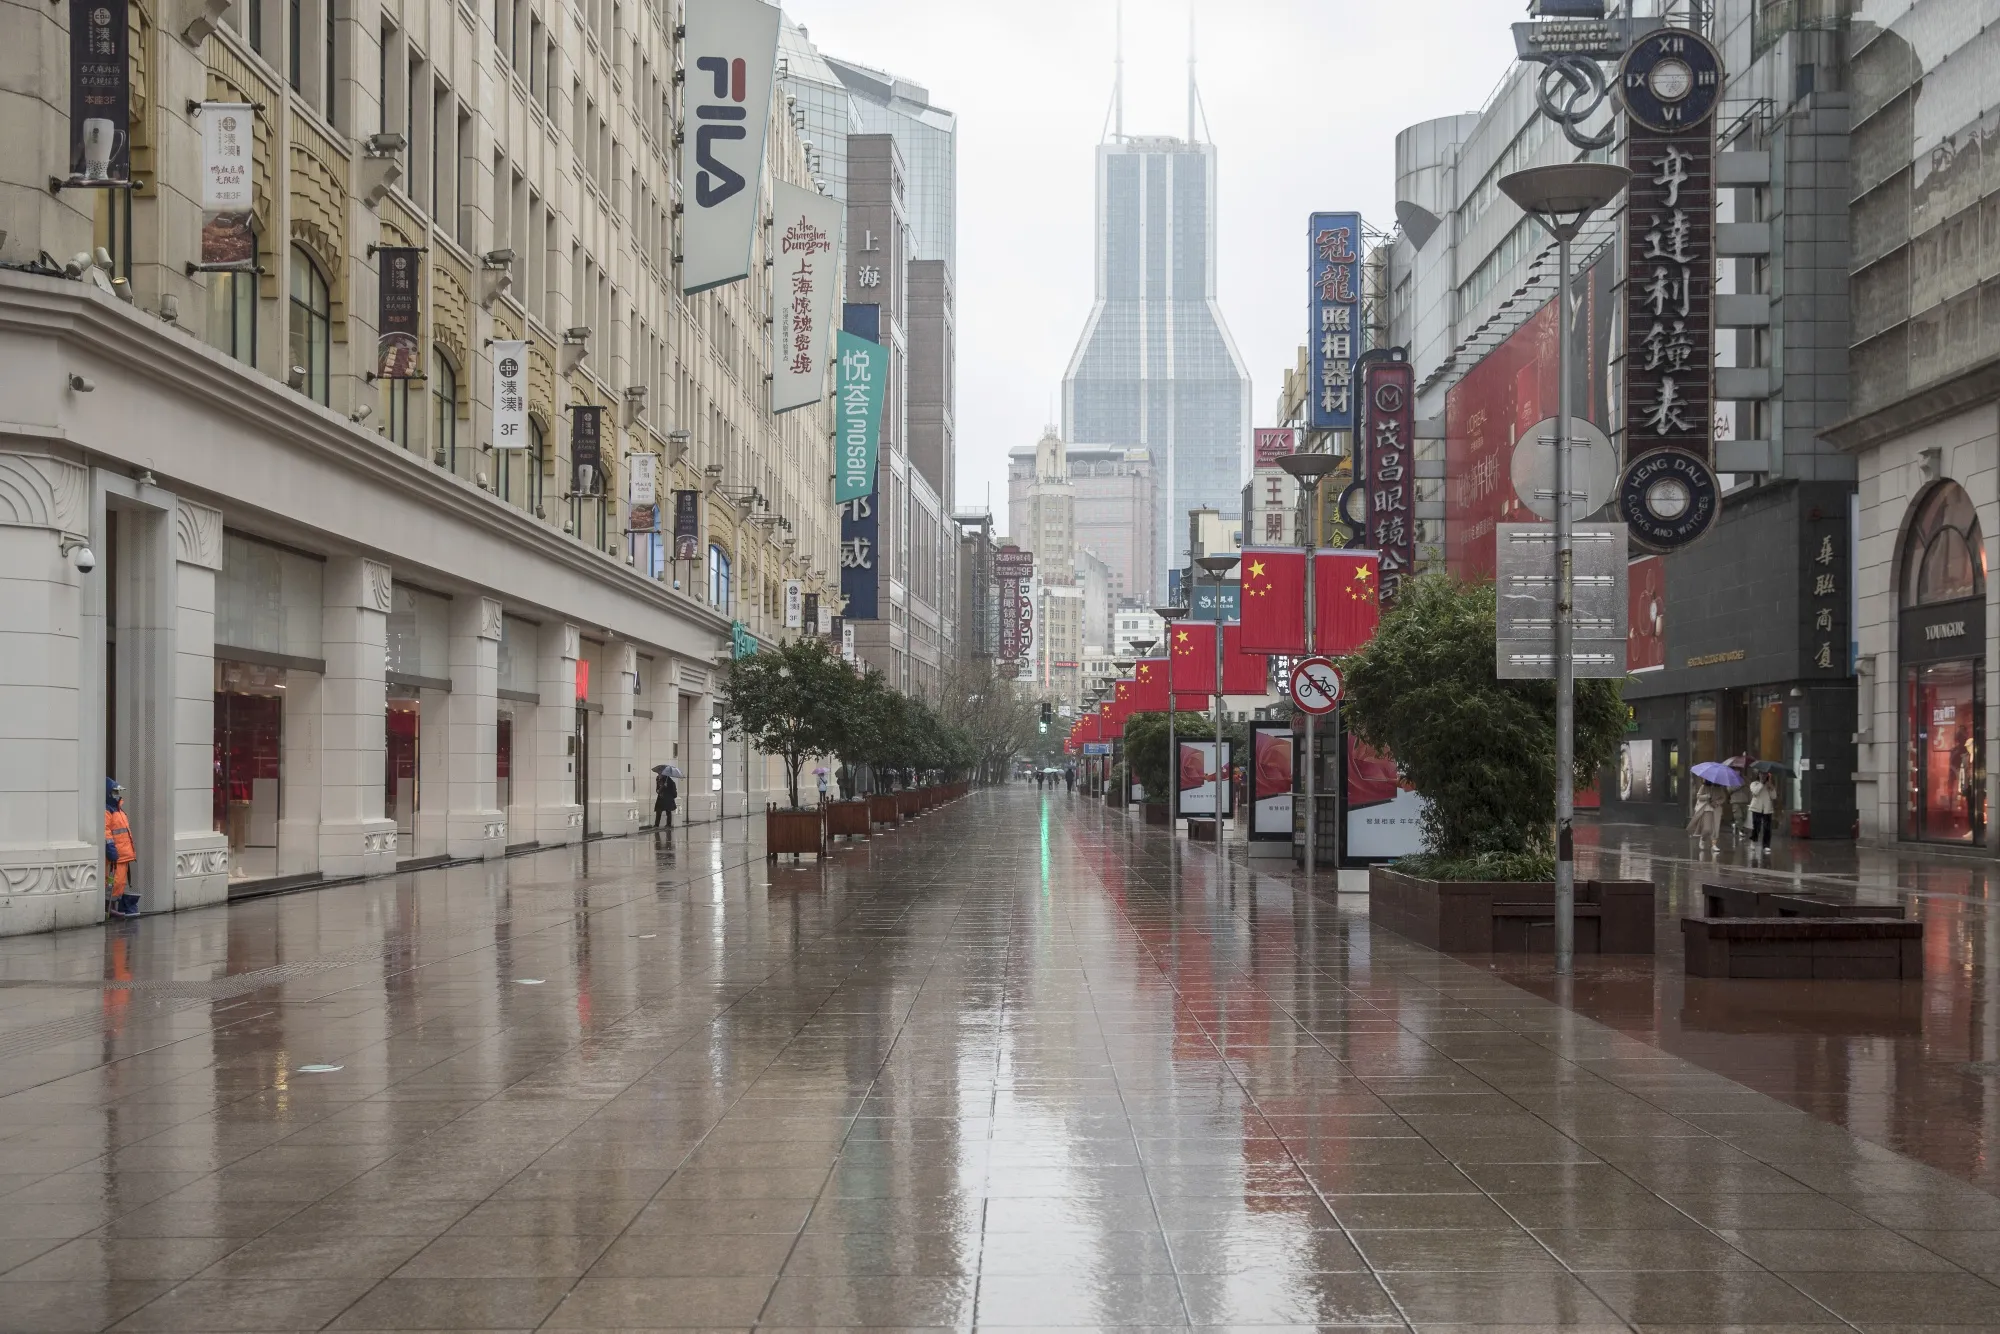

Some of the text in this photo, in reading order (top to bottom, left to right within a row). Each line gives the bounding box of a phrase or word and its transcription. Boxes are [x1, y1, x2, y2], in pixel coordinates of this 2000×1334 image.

[1659, 37, 1684, 53] XII
[1627, 73, 1646, 87] IX
[1698, 71, 1715, 86] III
[1662, 107, 1682, 121] VI
[696, 56, 747, 209] FILA
[797, 215, 814, 232] the
[858, 229, 881, 287] 上海
[842, 349, 871, 415] 悦荟
[500, 423, 519, 436] 3F
[1259, 433, 1289, 447] WK
[1630, 458, 1707, 488] HENG DALI
[1628, 494, 1709, 538] CLOCKS AND WATCHES
